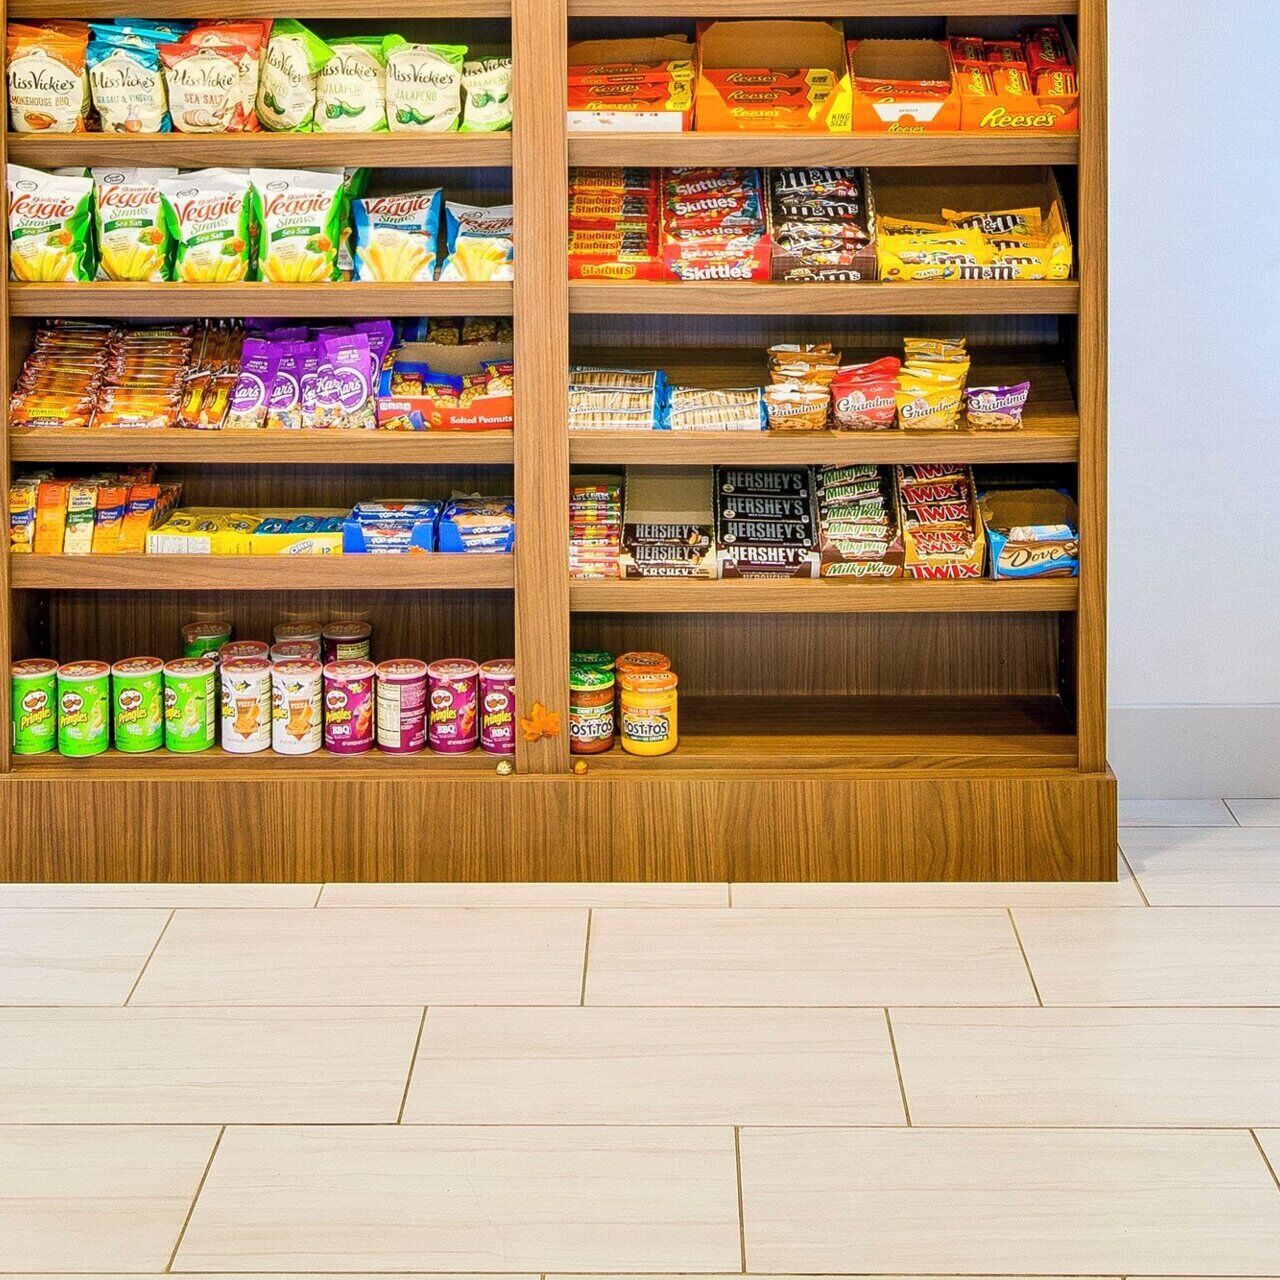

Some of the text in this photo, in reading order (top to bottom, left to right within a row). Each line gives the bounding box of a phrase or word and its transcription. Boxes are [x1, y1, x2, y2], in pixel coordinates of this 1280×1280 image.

[336, 55, 378, 81] Vickie's
[409, 63, 454, 90] Vickie's
[30, 68, 76, 95] Vickie's
[170, 68, 203, 88] Miss
[726, 72, 778, 85] Reese's
[11, 96, 71, 108] MOKEHOUSE BBQ
[184, 93, 225, 106] SEA SALT
[728, 89, 780, 102] Reese's
[730, 107, 781, 118] Reese's
[831, 113, 850, 121] KING
[979, 107, 1057, 128] Reese's
[675, 178, 737, 196] Skittles
[96, 183, 162, 209] Veggie
[576, 196, 622, 205] Starburst
[9, 191, 75, 220] Veggie
[174, 195, 242, 227] Veggie
[264, 192, 332, 219] Veggie
[365, 196, 431, 216] Veggie
[575, 204, 622, 214] Starburst
[675, 197, 738, 216] Skittles
[576, 231, 623, 240] Starburst
[679, 226, 744, 238] Skittles
[573, 241, 622, 250] Starburst
[582, 264, 636, 275] Starburst
[681, 263, 753, 281] Skittles
[960, 264, 1021, 280] m&m's
[273, 381, 295, 396] ar's
[450, 416, 513, 424] Salted Peanuts
[726, 471, 803, 490] HERSHEY'S
[826, 480, 879, 502] Milky Way
[902, 484, 958, 504] TWIX
[727, 497, 804, 516] HERSHEY'S
[827, 505, 885, 522] Milky Way
[908, 503, 969, 524] TWIX
[635, 524, 699, 540] HERSHEY'S
[728, 521, 806, 539] HERSHEY'S
[828, 522, 887, 538] Milky Way
[636, 546, 700, 562] HERSHEY'S
[729, 546, 808, 563] HERSHEY'S
[999, 547, 1067, 567] Dove
[826, 562, 898, 577] Milky Way
[905, 561, 982, 578] TWIX
[21, 707, 51, 731] Pringles
[60, 710, 88, 727] Pringles
[119, 706, 148, 727] Pringles
[326, 708, 352, 724] Pringles
[430, 708, 457, 724] Pringles
[483, 711, 512, 728] Pringles
[332, 726, 351, 735] BBQ
[436, 725, 456, 735] BBQ
[491, 728, 511, 738] BBQ
